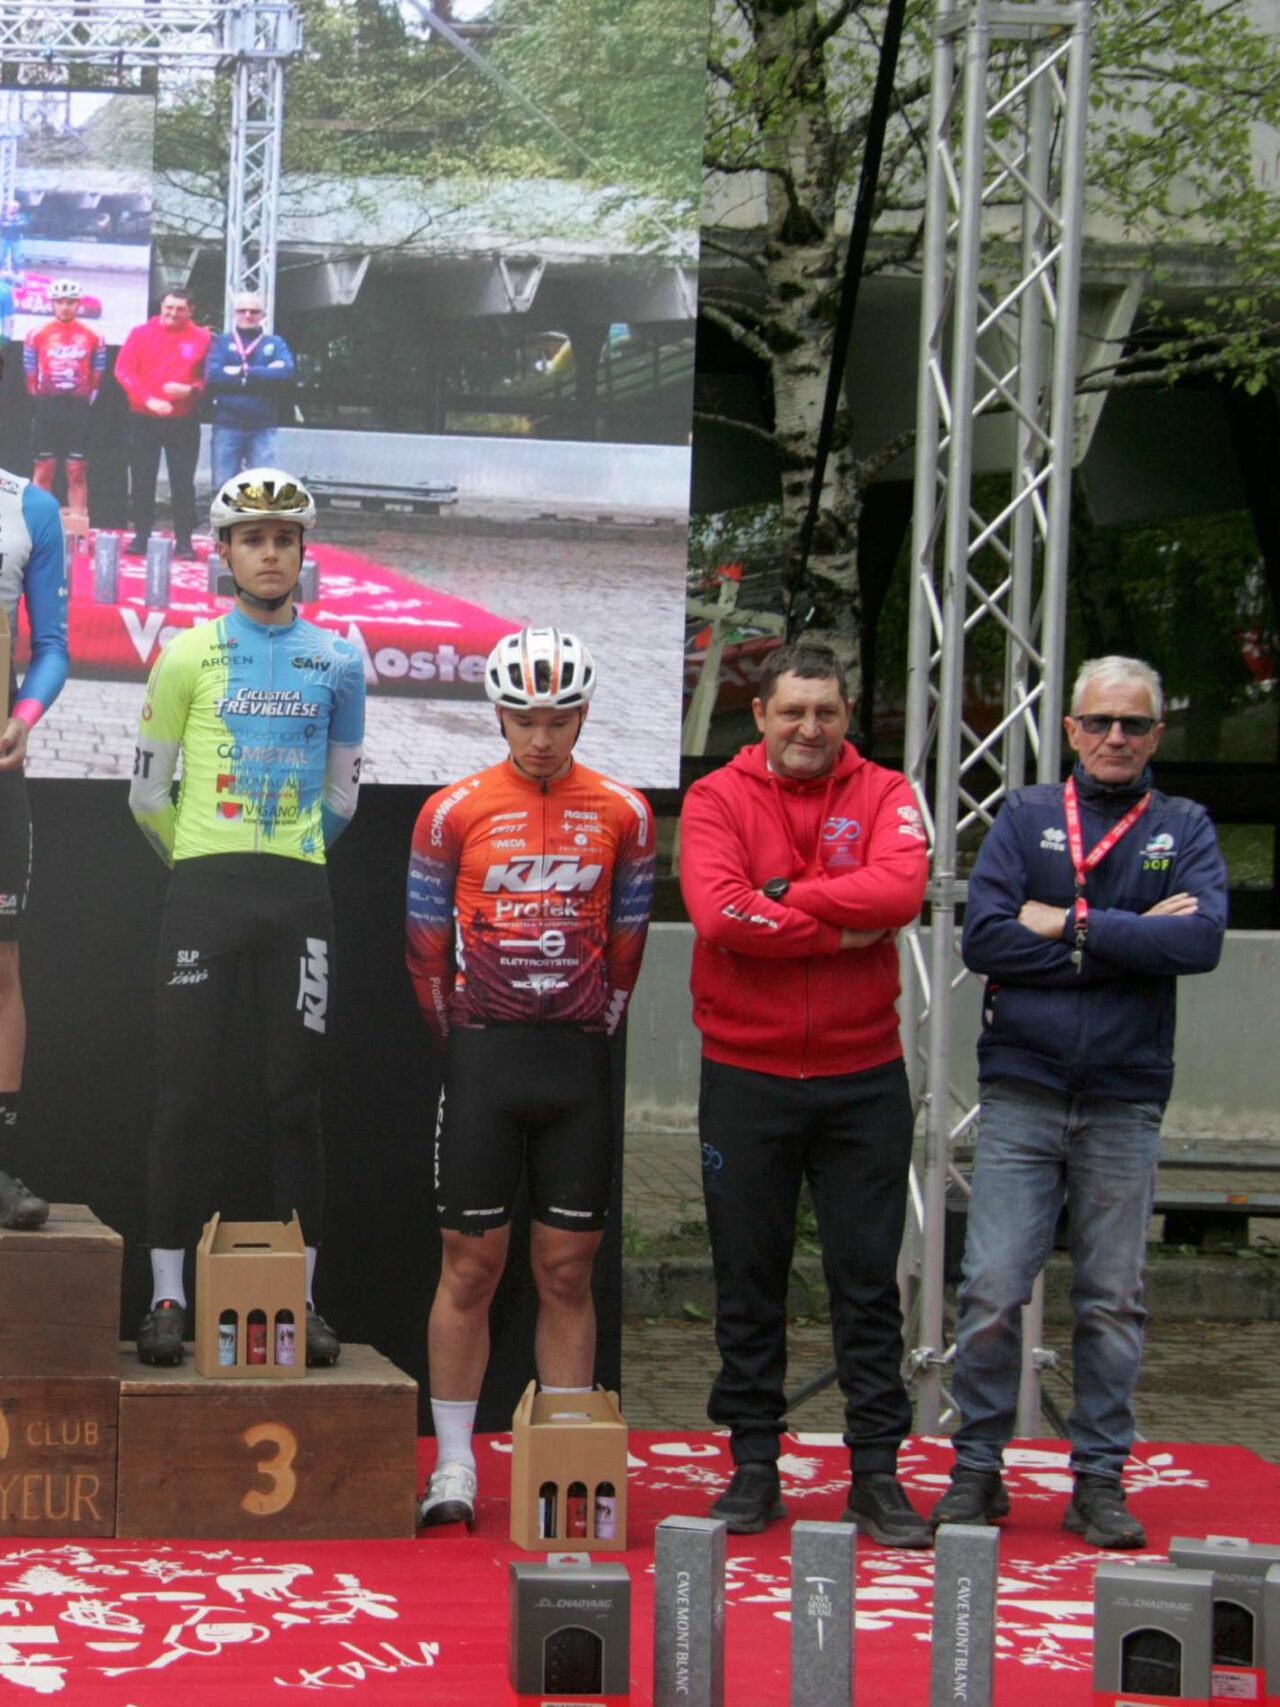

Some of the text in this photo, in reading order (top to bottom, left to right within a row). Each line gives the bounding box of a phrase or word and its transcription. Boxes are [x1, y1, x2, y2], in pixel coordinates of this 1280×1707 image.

[245, 803, 297, 818] VGANO
[430, 786, 471, 847] SCHWALBE
[482, 854, 603, 893] KTM
[495, 897, 578, 921] Protek
[176, 949, 200, 964] SLP
[296, 937, 329, 1035] KTM
[26, 1420, 99, 1447] CLUB
[241, 1421, 299, 1515] 3
[676, 1571, 690, 1695] CAVE MONT BLANC
[953, 1576, 971, 1701] CAVE MONT BLANC
